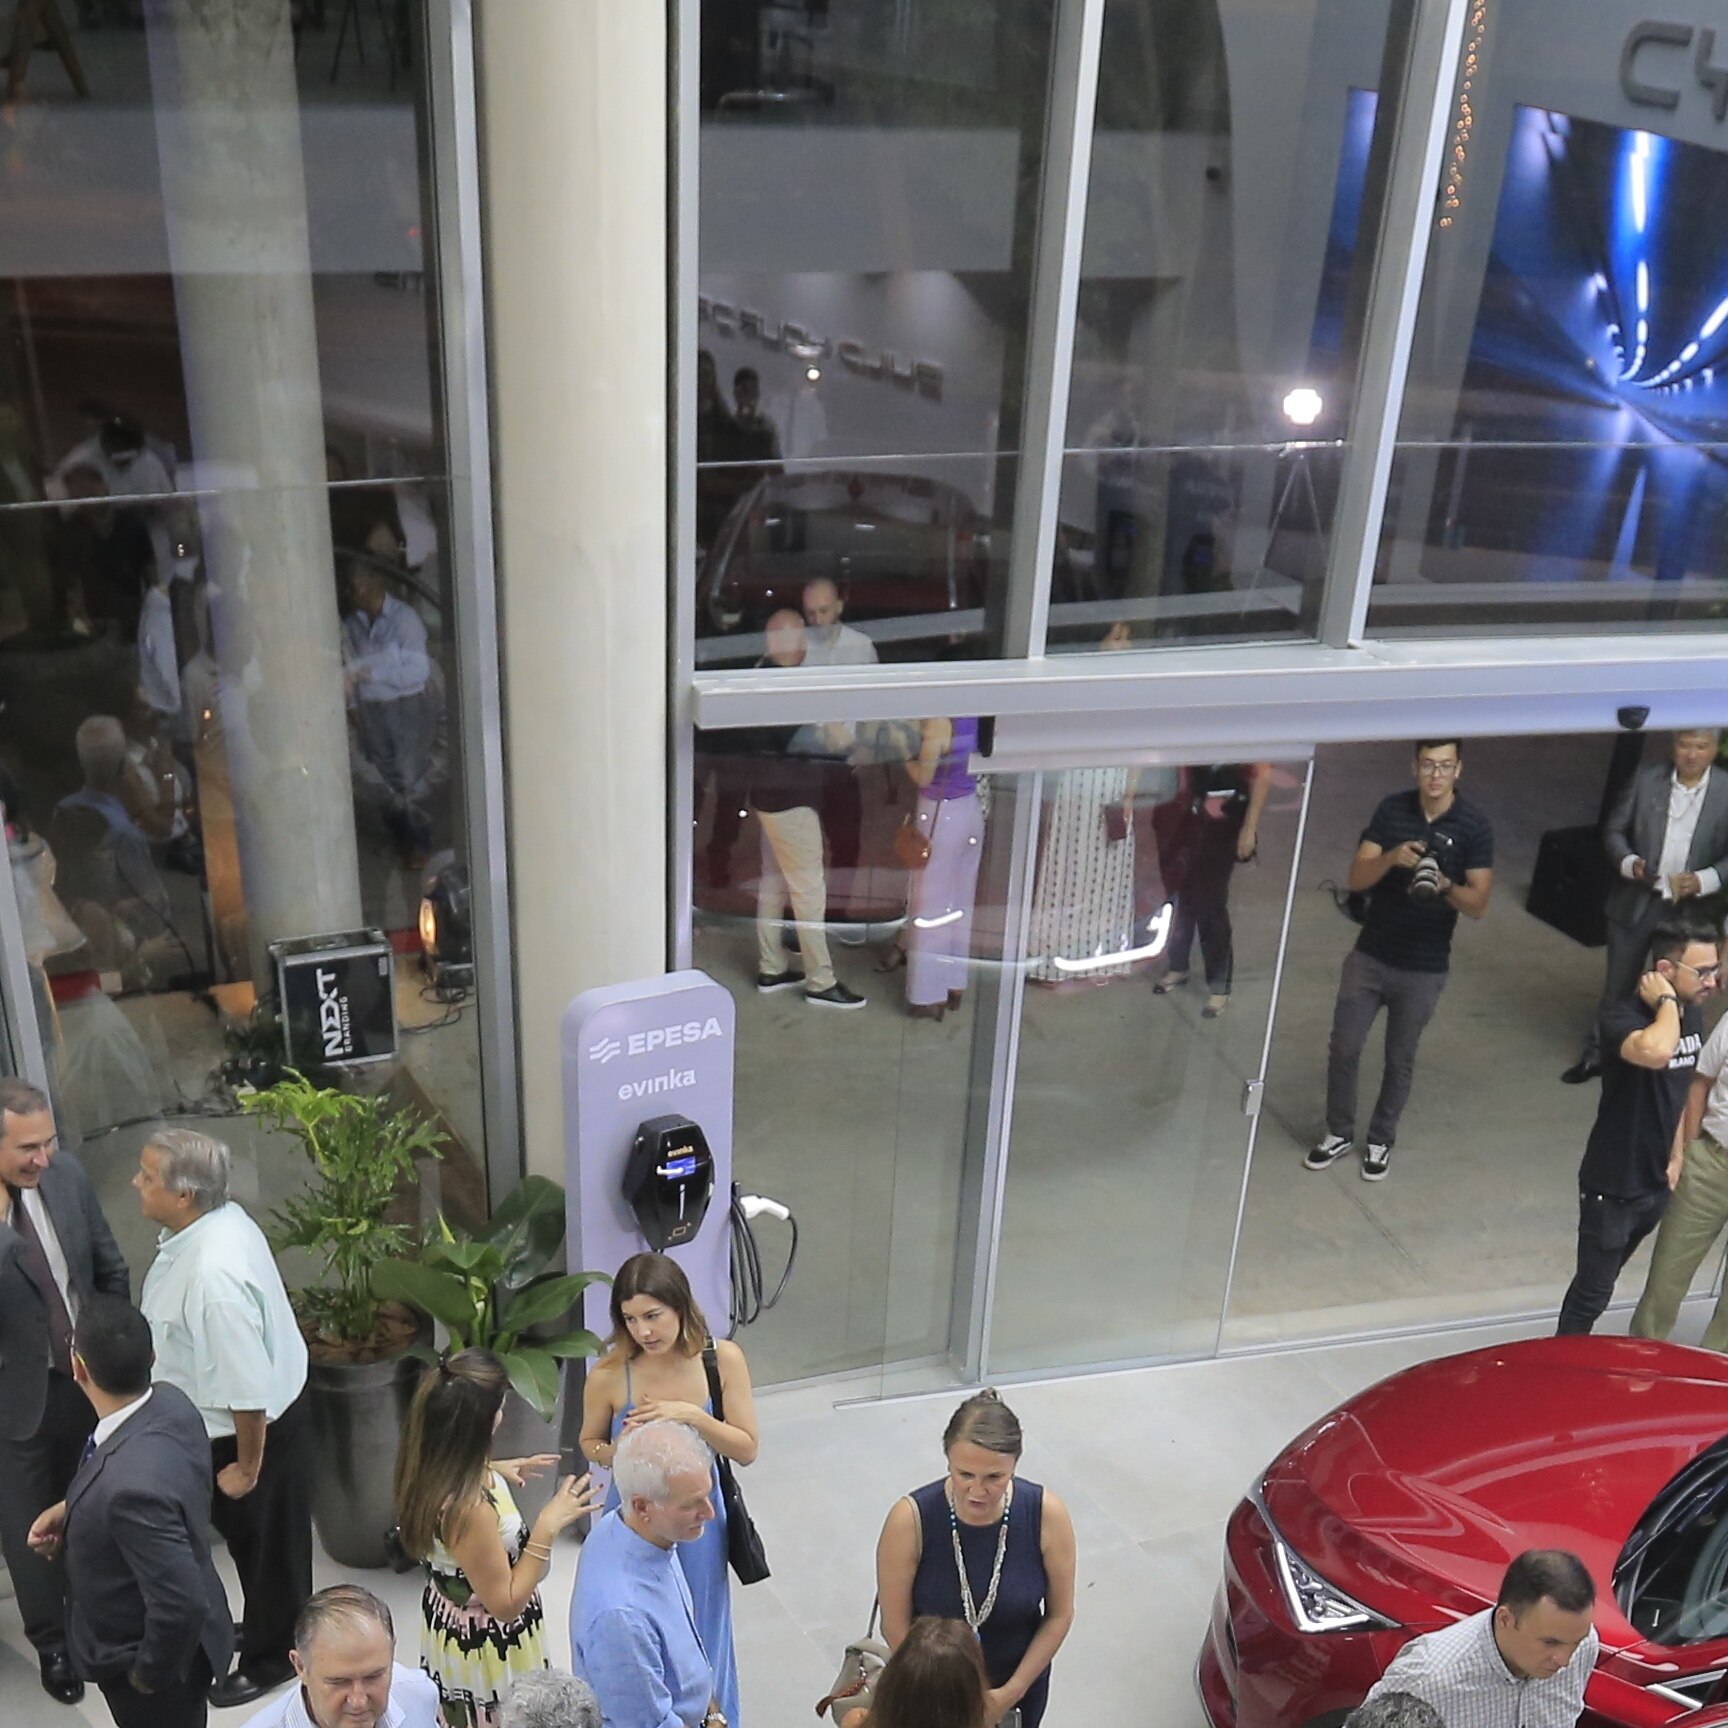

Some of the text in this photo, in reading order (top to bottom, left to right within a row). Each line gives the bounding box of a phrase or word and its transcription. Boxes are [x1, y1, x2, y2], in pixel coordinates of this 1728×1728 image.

[316, 968, 344, 1057] NEXT
[339, 996, 353, 1053] BRANDING
[627, 1017, 723, 1056] EPESA
[618, 1068, 697, 1101] evinka
